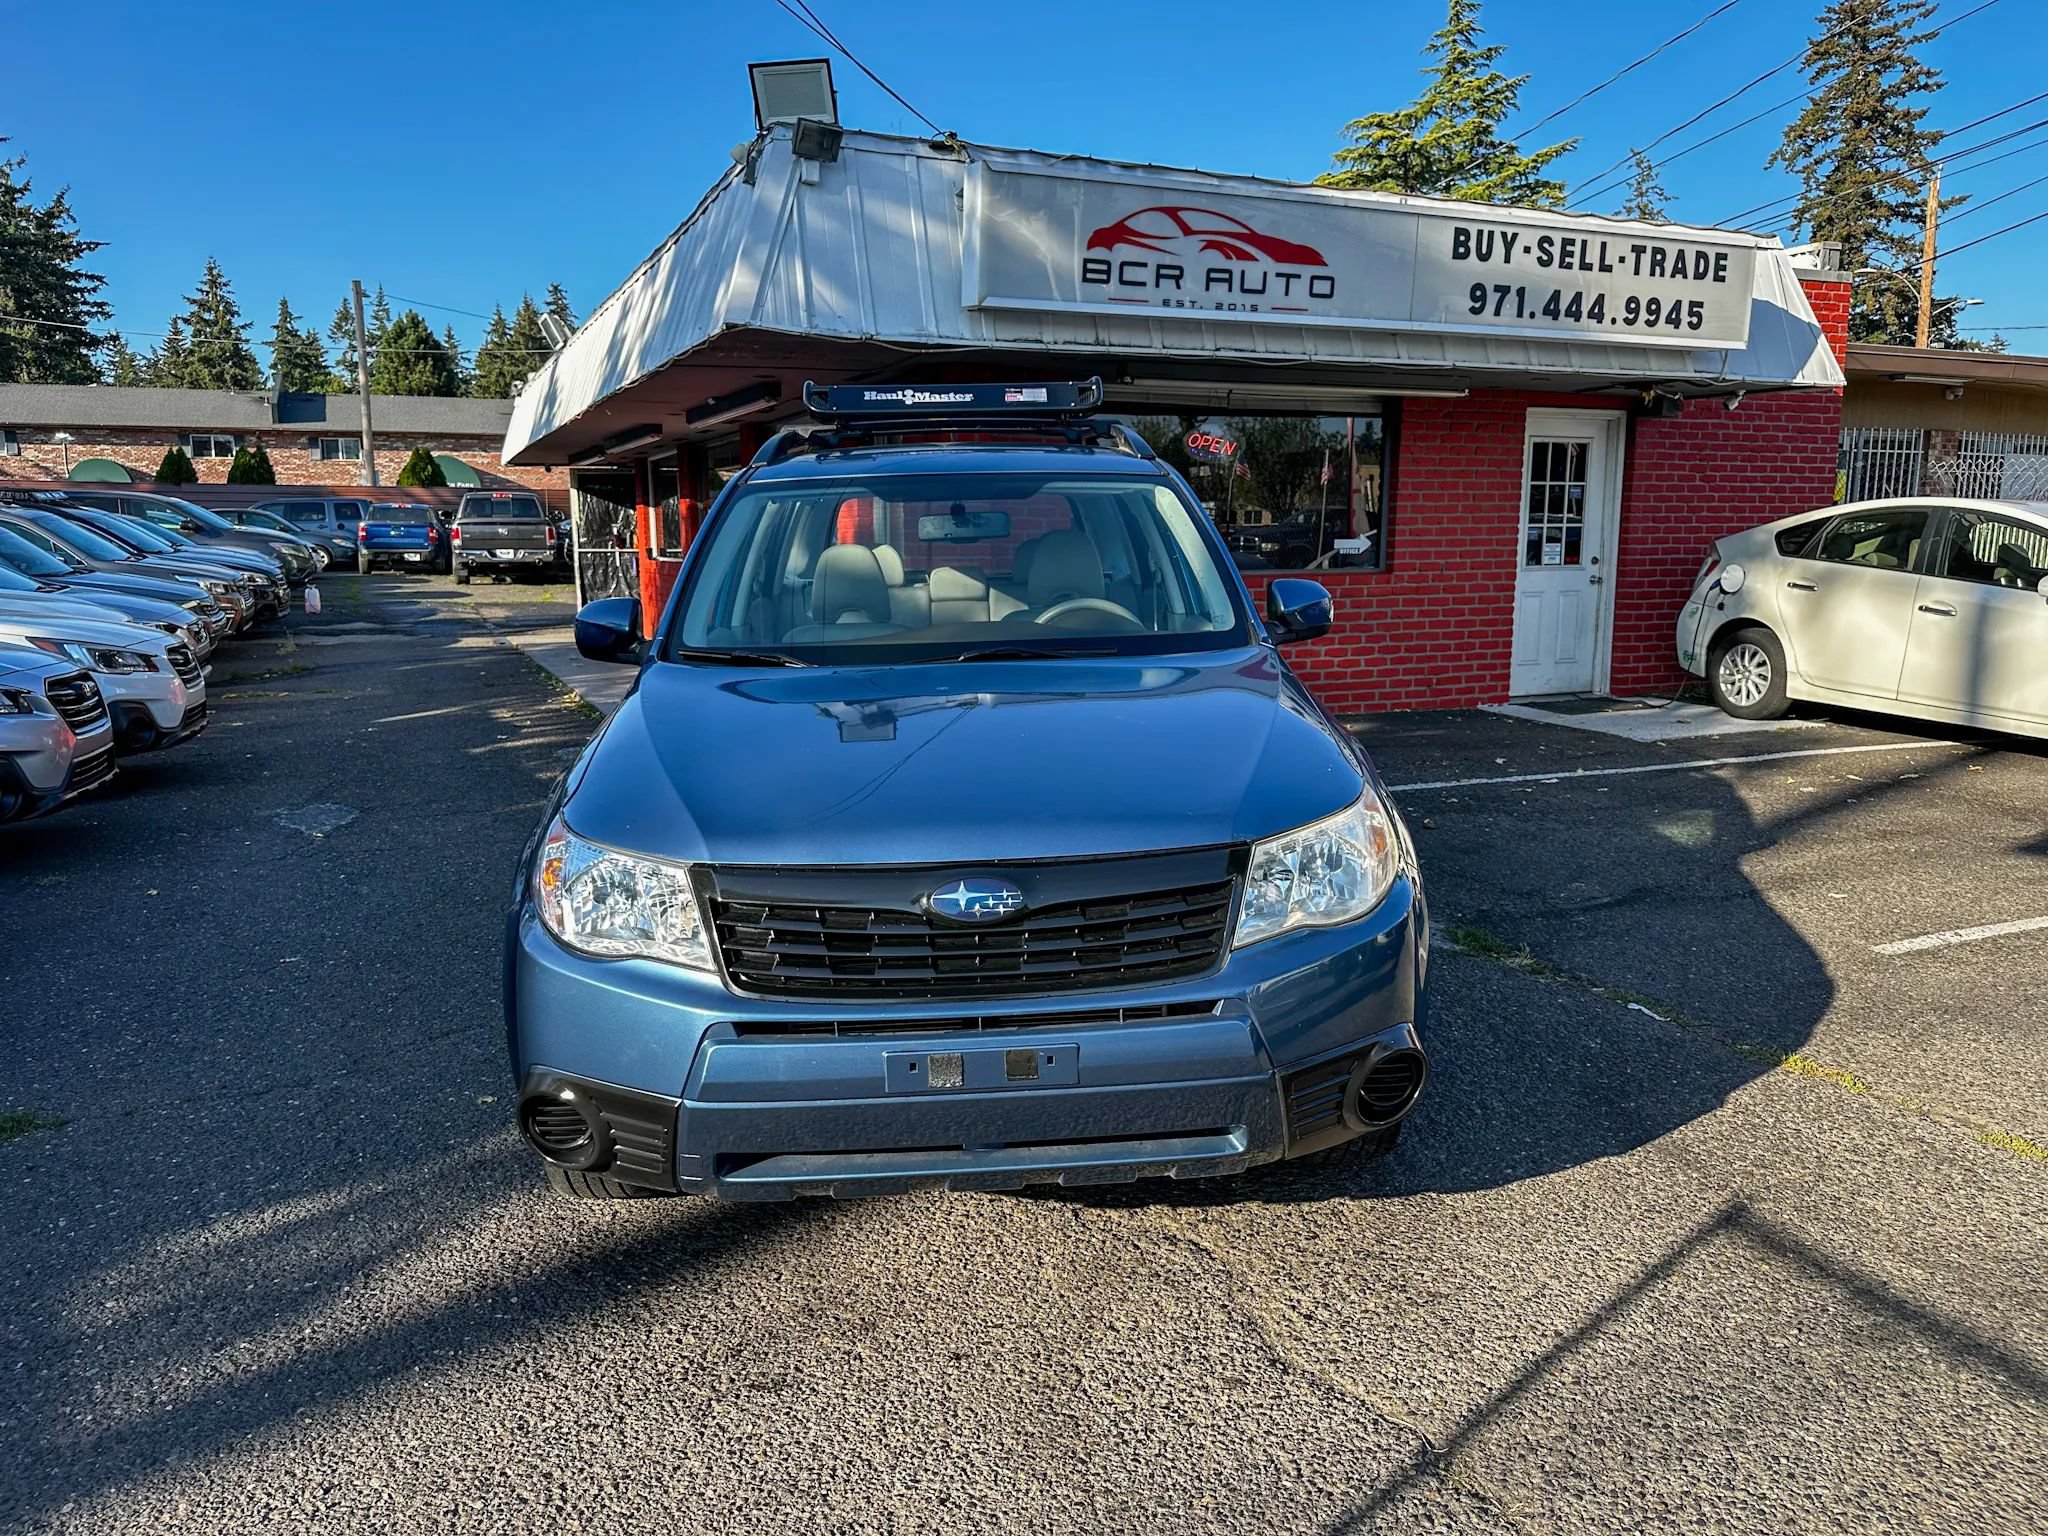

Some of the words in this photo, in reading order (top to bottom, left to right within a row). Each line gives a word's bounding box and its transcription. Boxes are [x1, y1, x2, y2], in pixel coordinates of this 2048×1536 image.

[1082, 257, 1184, 290] BCR
[1205, 267, 1335, 299] AUTO
[1162, 298, 1203, 310] EST.
[1214, 302, 1259, 312] 2015
[1468, 282, 1704, 331] 971.444.9945
[1188, 433, 1237, 456] OPEN
